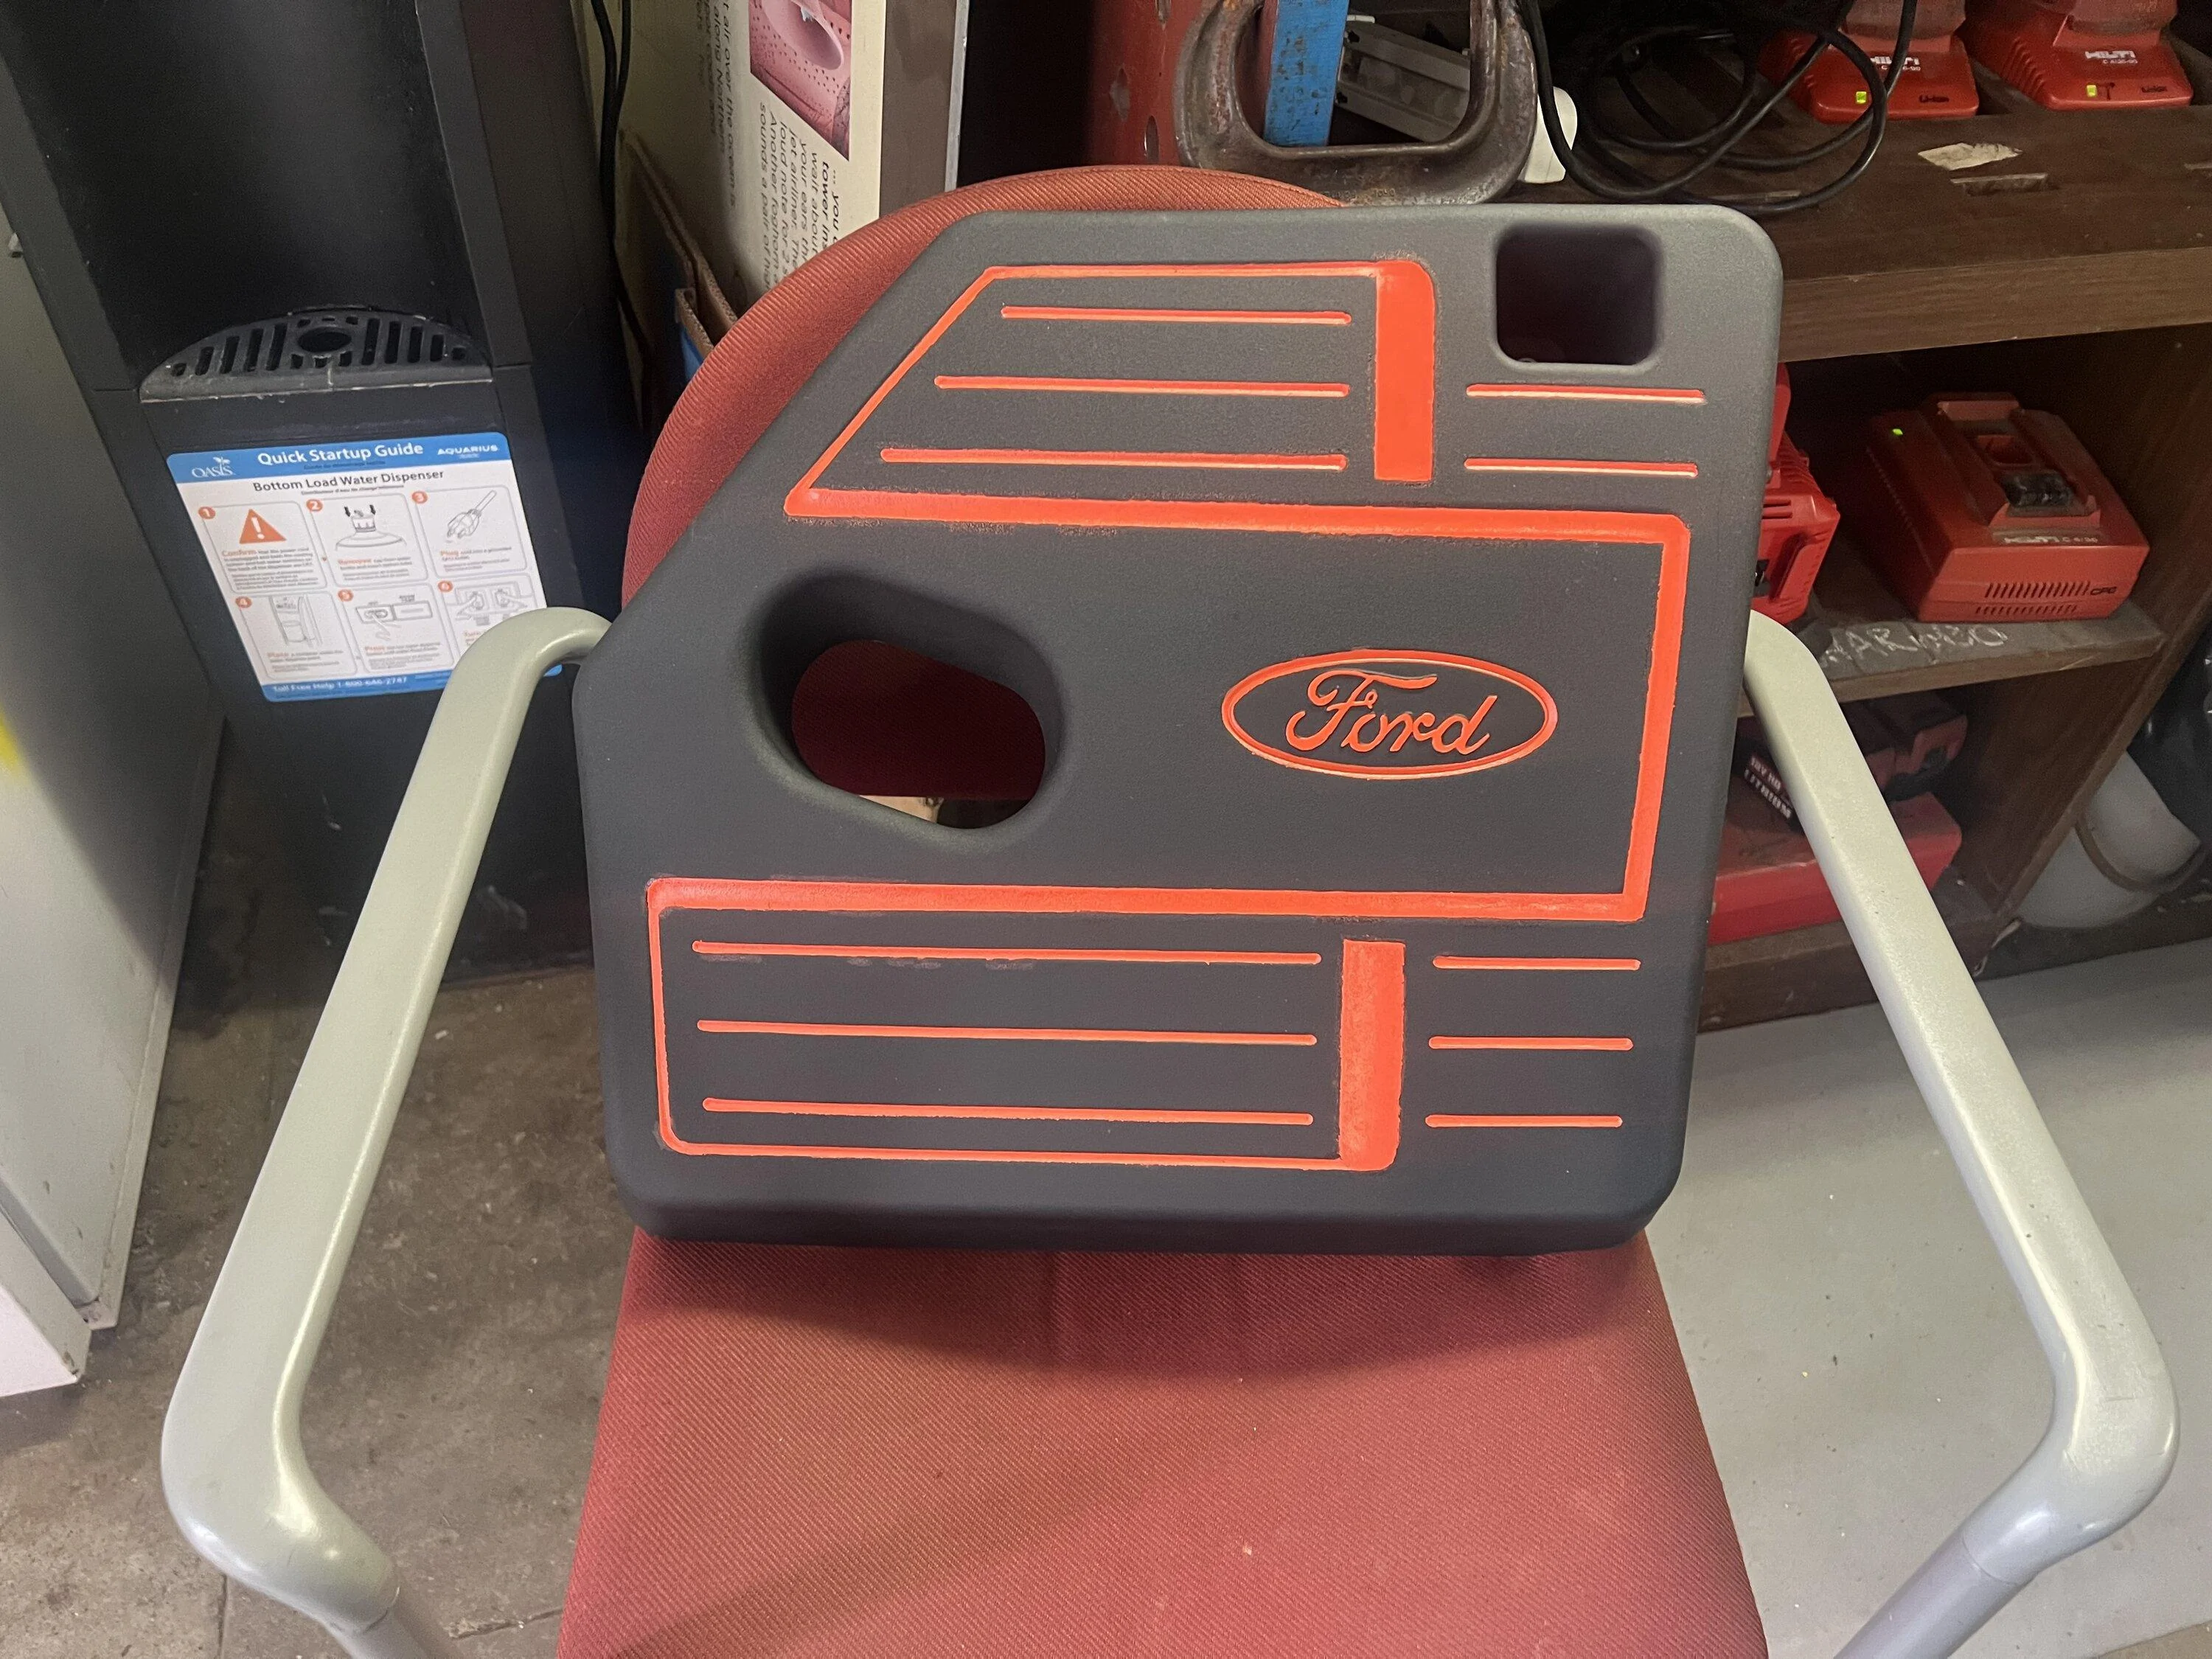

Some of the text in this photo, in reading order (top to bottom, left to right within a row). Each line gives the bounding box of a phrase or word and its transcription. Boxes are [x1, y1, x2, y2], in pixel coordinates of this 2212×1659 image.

[769, 110, 778, 193] Another
[780, 121, 788, 167] loud
[789, 128, 799, 158] jet
[799, 139, 807, 187] your
[258, 450, 308, 465] Quick
[309, 448, 372, 461] Startup
[375, 442, 423, 456] Guide
[437, 445, 498, 456] AQUARIUS
[191, 462, 235, 478] OASIS
[253, 481, 303, 492] Bottom
[305, 477, 338, 488] Load
[339, 475, 378, 485] Water
[380, 470, 444, 484] Dispenser
[1285, 668, 1498, 756] Ford
